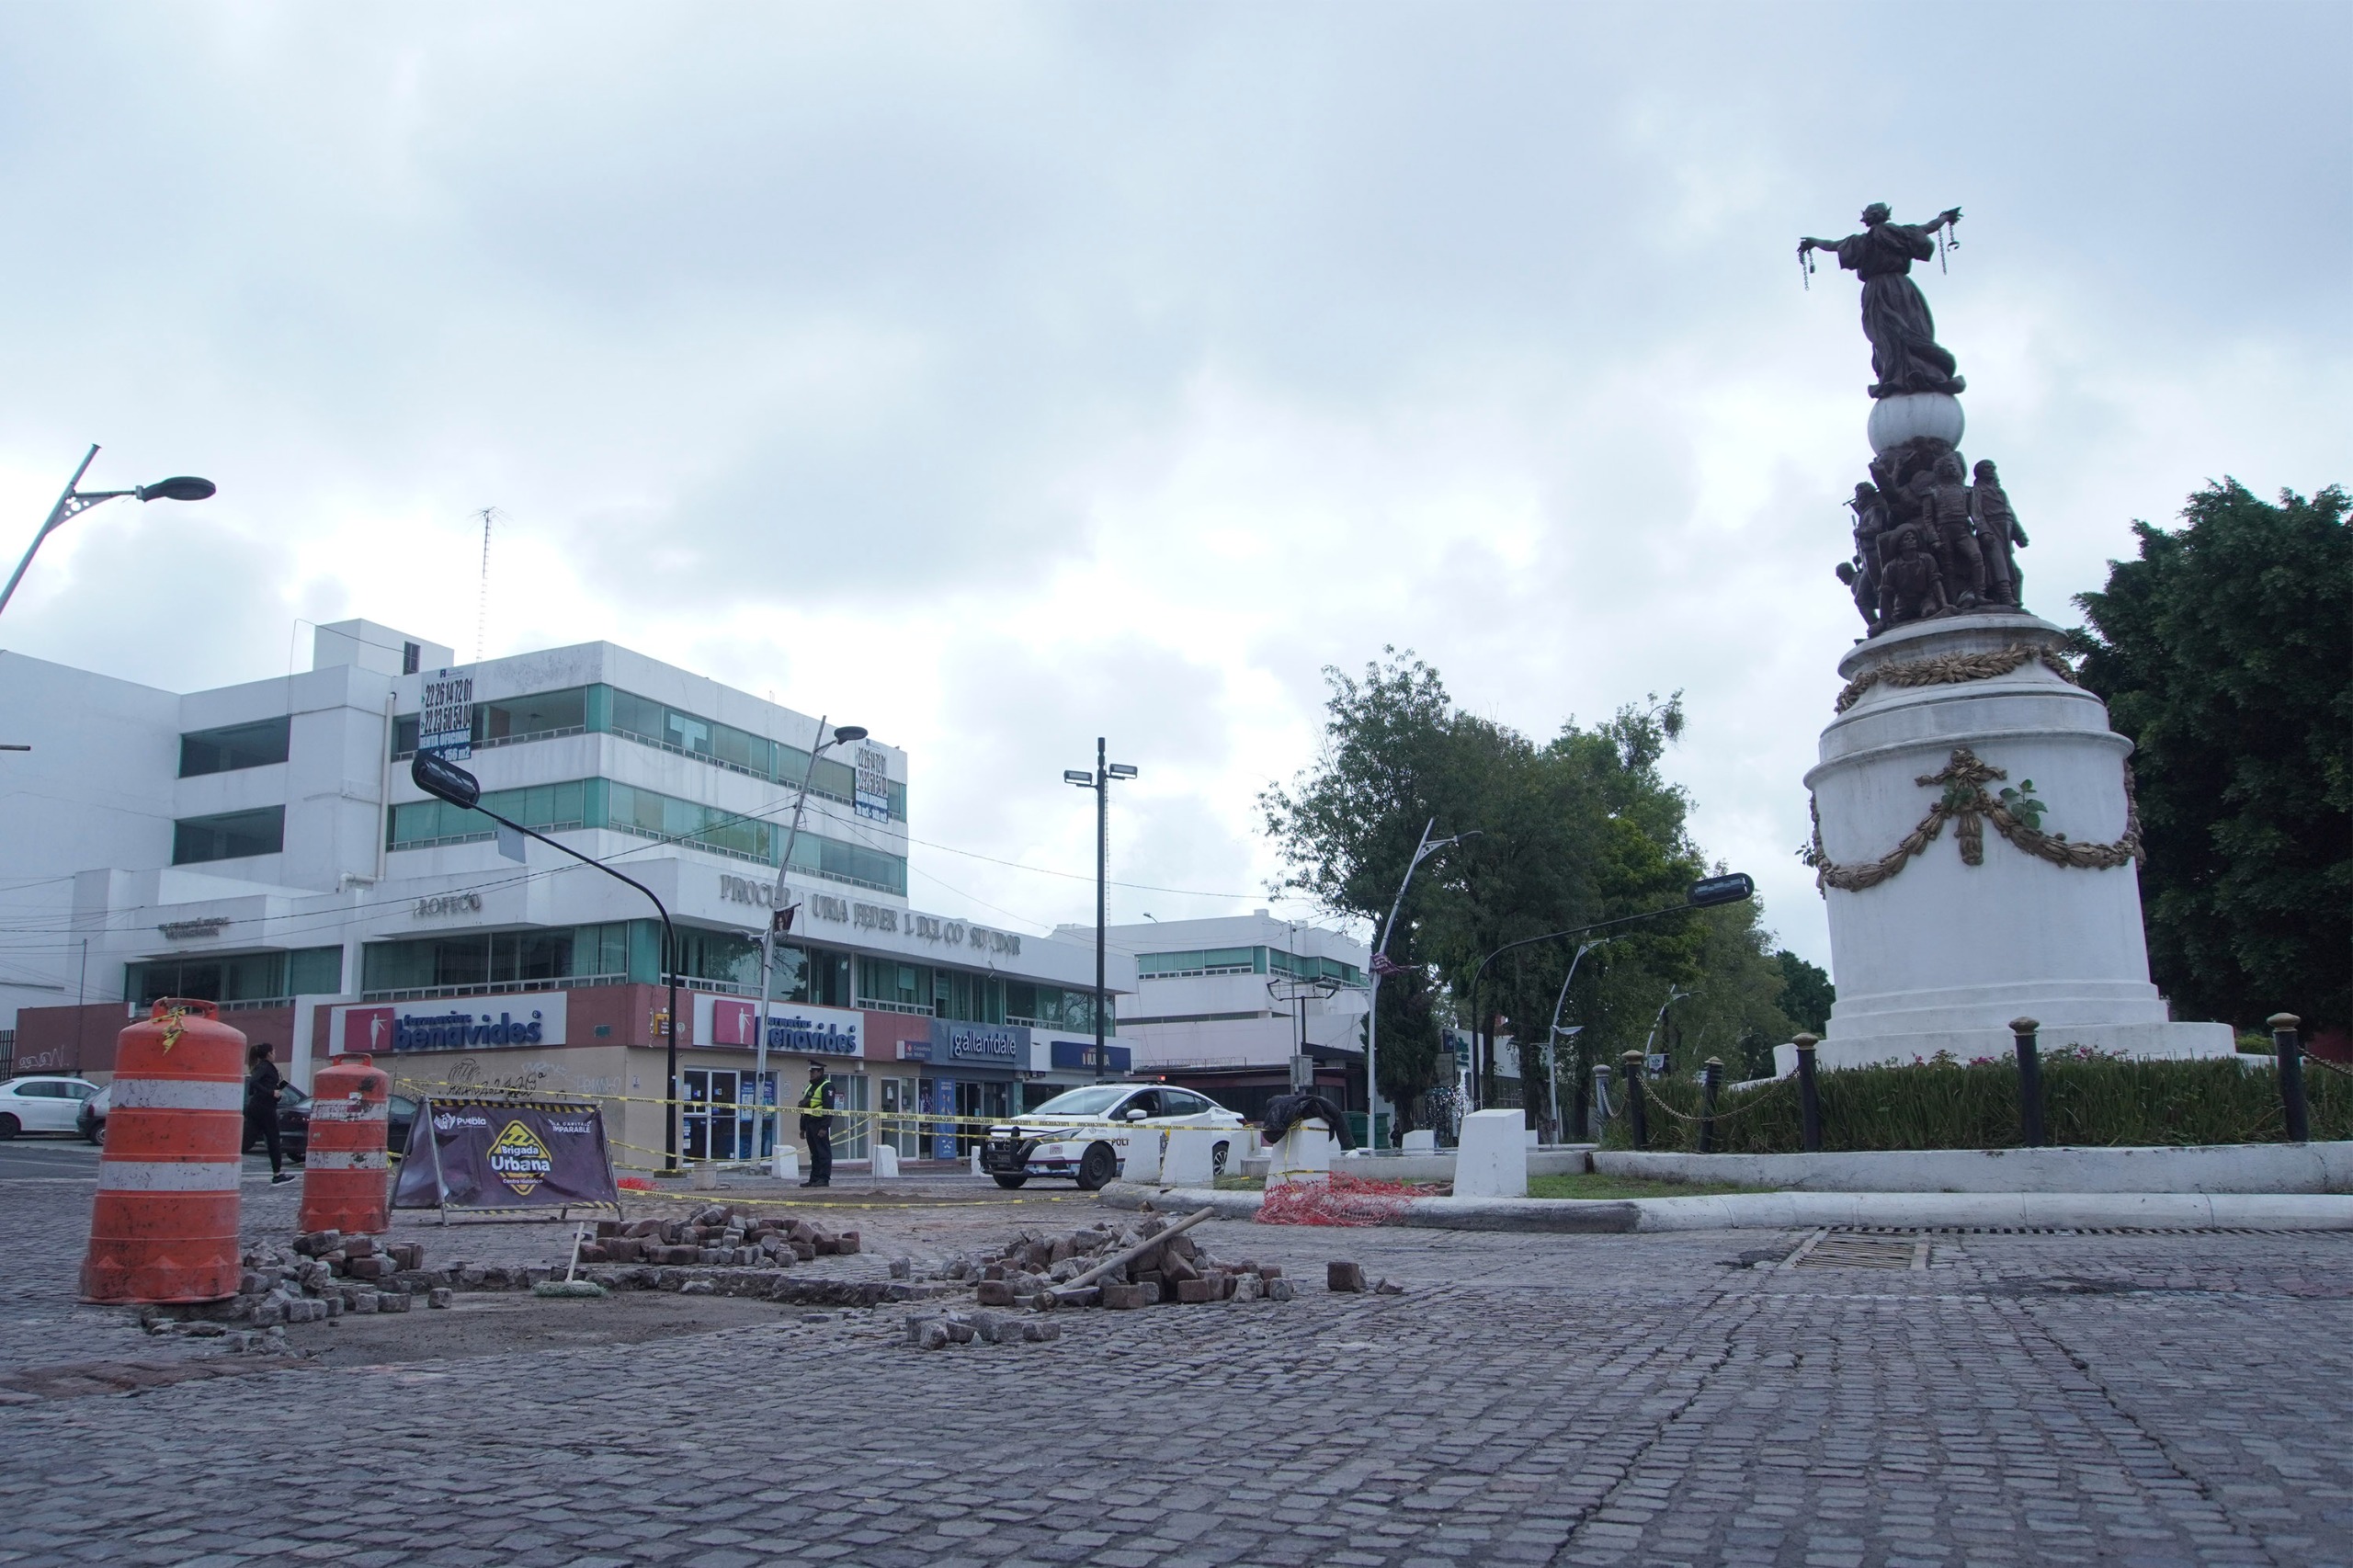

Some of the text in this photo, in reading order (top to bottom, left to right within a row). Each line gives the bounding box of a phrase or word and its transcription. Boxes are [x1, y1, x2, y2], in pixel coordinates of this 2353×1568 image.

[426, 678, 472, 708] 22 26 14 72 01
[425, 710, 433, 733] 22
[434, 708, 442, 732] 23
[443, 707, 452, 730] 50
[439, 730, 471, 746] OFICINAS
[444, 748, 458, 761] 156
[458, 746, 470, 759] m2
[404, 1011, 472, 1025] farmacias
[767, 1016, 812, 1028] armacias
[395, 1013, 541, 1049] benavides
[954, 1029, 1016, 1056] gallantdale
[457, 1117, 486, 1125] Puebla
[1111, 1138, 1129, 1146] POLI
[502, 1145, 539, 1156] Brigada
[492, 1156, 551, 1171] Urbana
